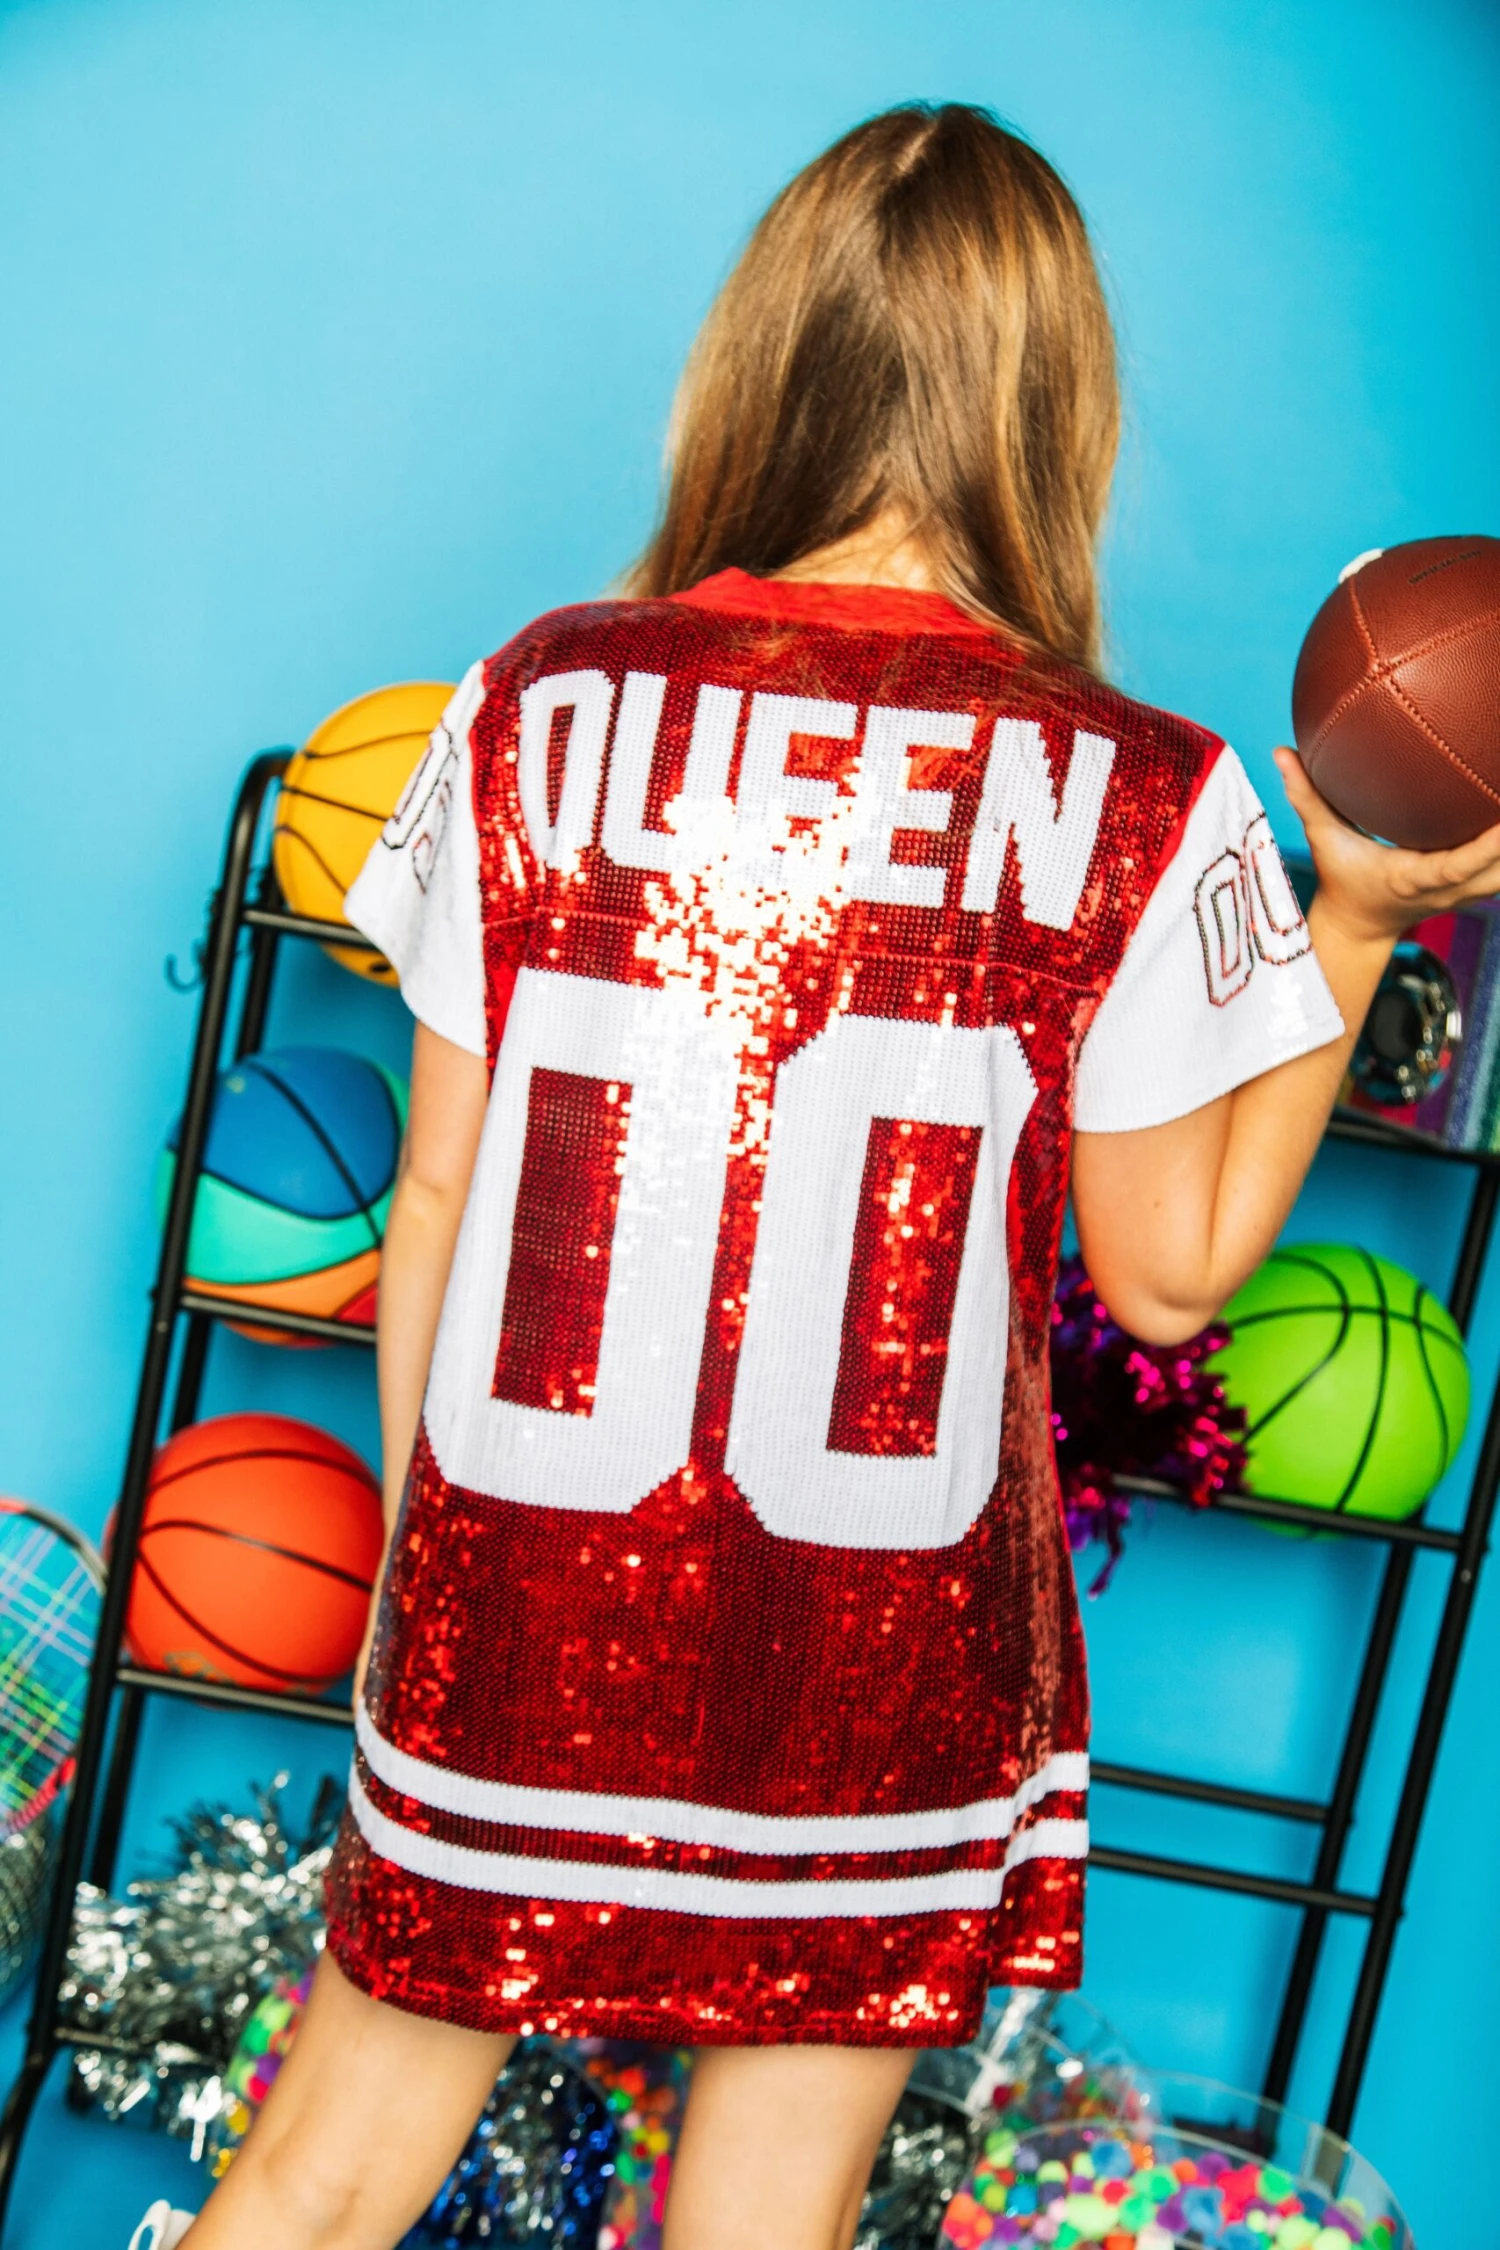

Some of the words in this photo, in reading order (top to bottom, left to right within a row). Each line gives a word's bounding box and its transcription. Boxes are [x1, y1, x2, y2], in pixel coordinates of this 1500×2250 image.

[518, 668, 1117, 931] QUEEN
[1193, 812, 1313, 1007] 00
[422, 967, 1039, 1550] 00
